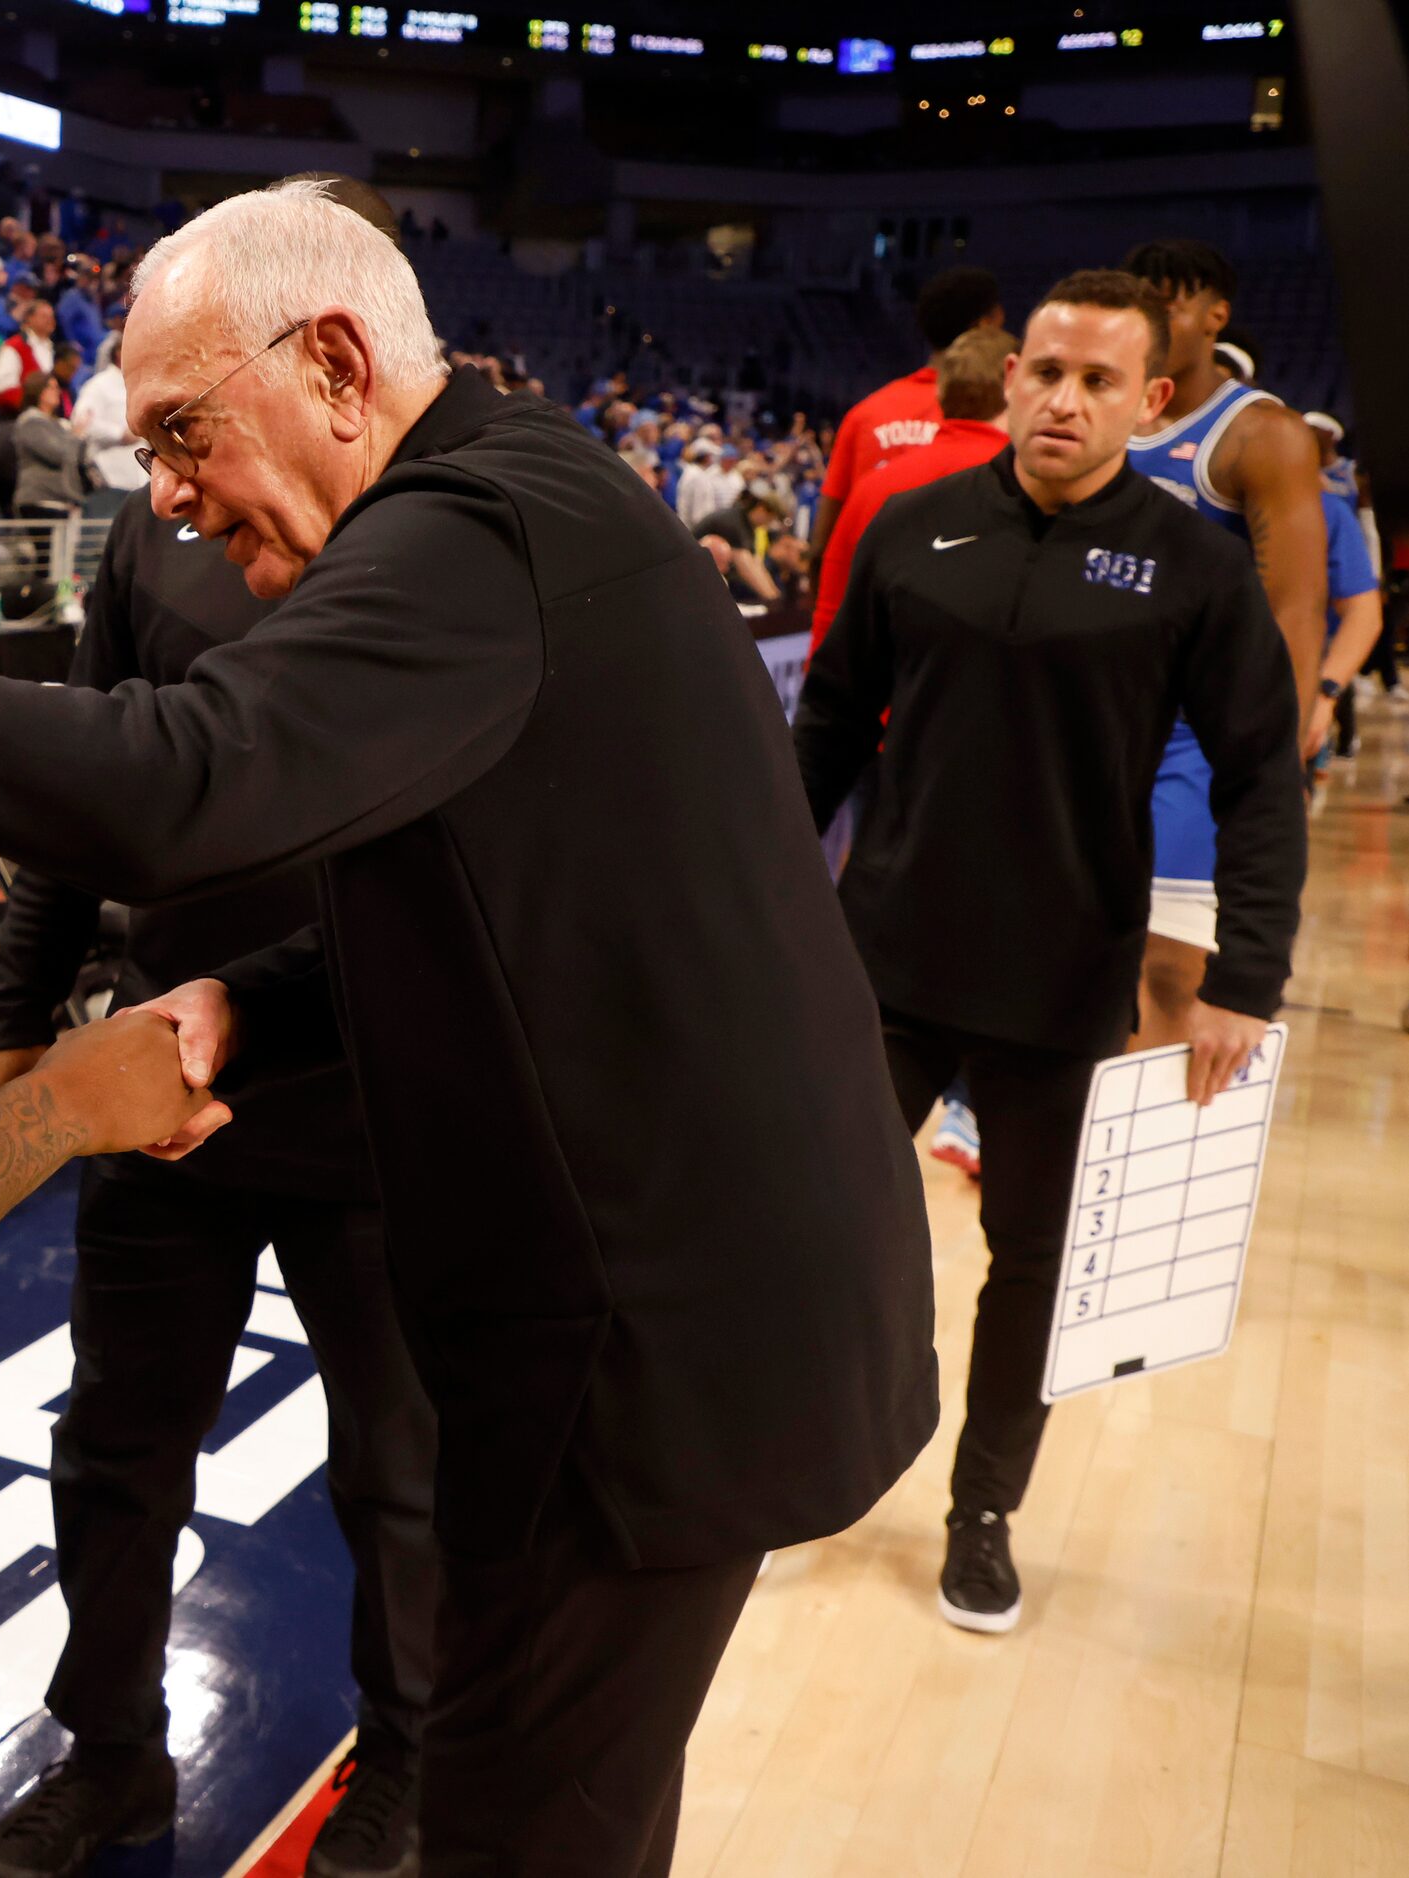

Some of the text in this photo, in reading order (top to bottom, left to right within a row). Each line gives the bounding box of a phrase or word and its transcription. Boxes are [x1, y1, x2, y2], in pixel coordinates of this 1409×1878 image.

[1084, 546, 1157, 593] 901
[1104, 1127, 1114, 1152] 1
[1097, 1169, 1112, 1195] 2
[1089, 1211, 1104, 1236] 3
[1083, 1252, 1096, 1276] 4
[1076, 1292, 1090, 1317] 5
